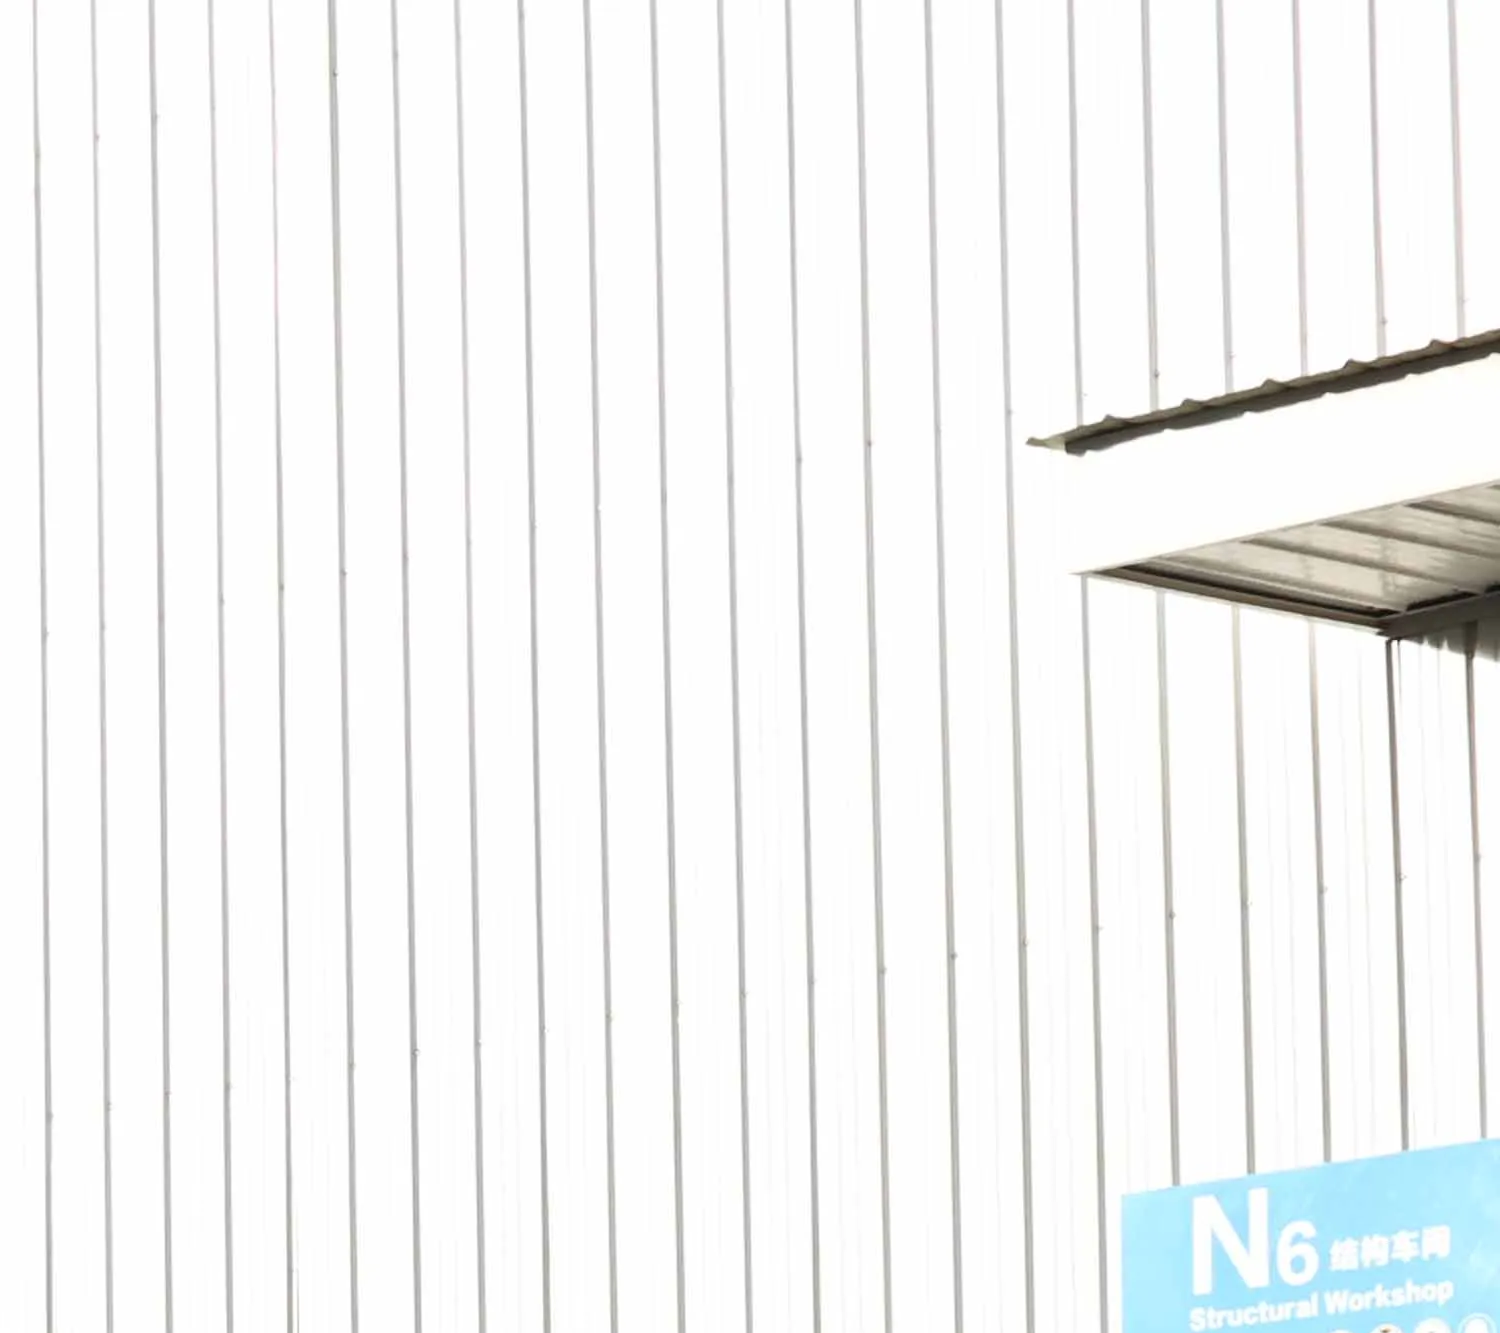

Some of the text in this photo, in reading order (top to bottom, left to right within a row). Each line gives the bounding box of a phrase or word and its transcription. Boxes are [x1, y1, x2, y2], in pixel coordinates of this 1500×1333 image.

[1191, 1187, 1320, 1296] N6
[1189, 1279, 1455, 1333] Structural Workshop
